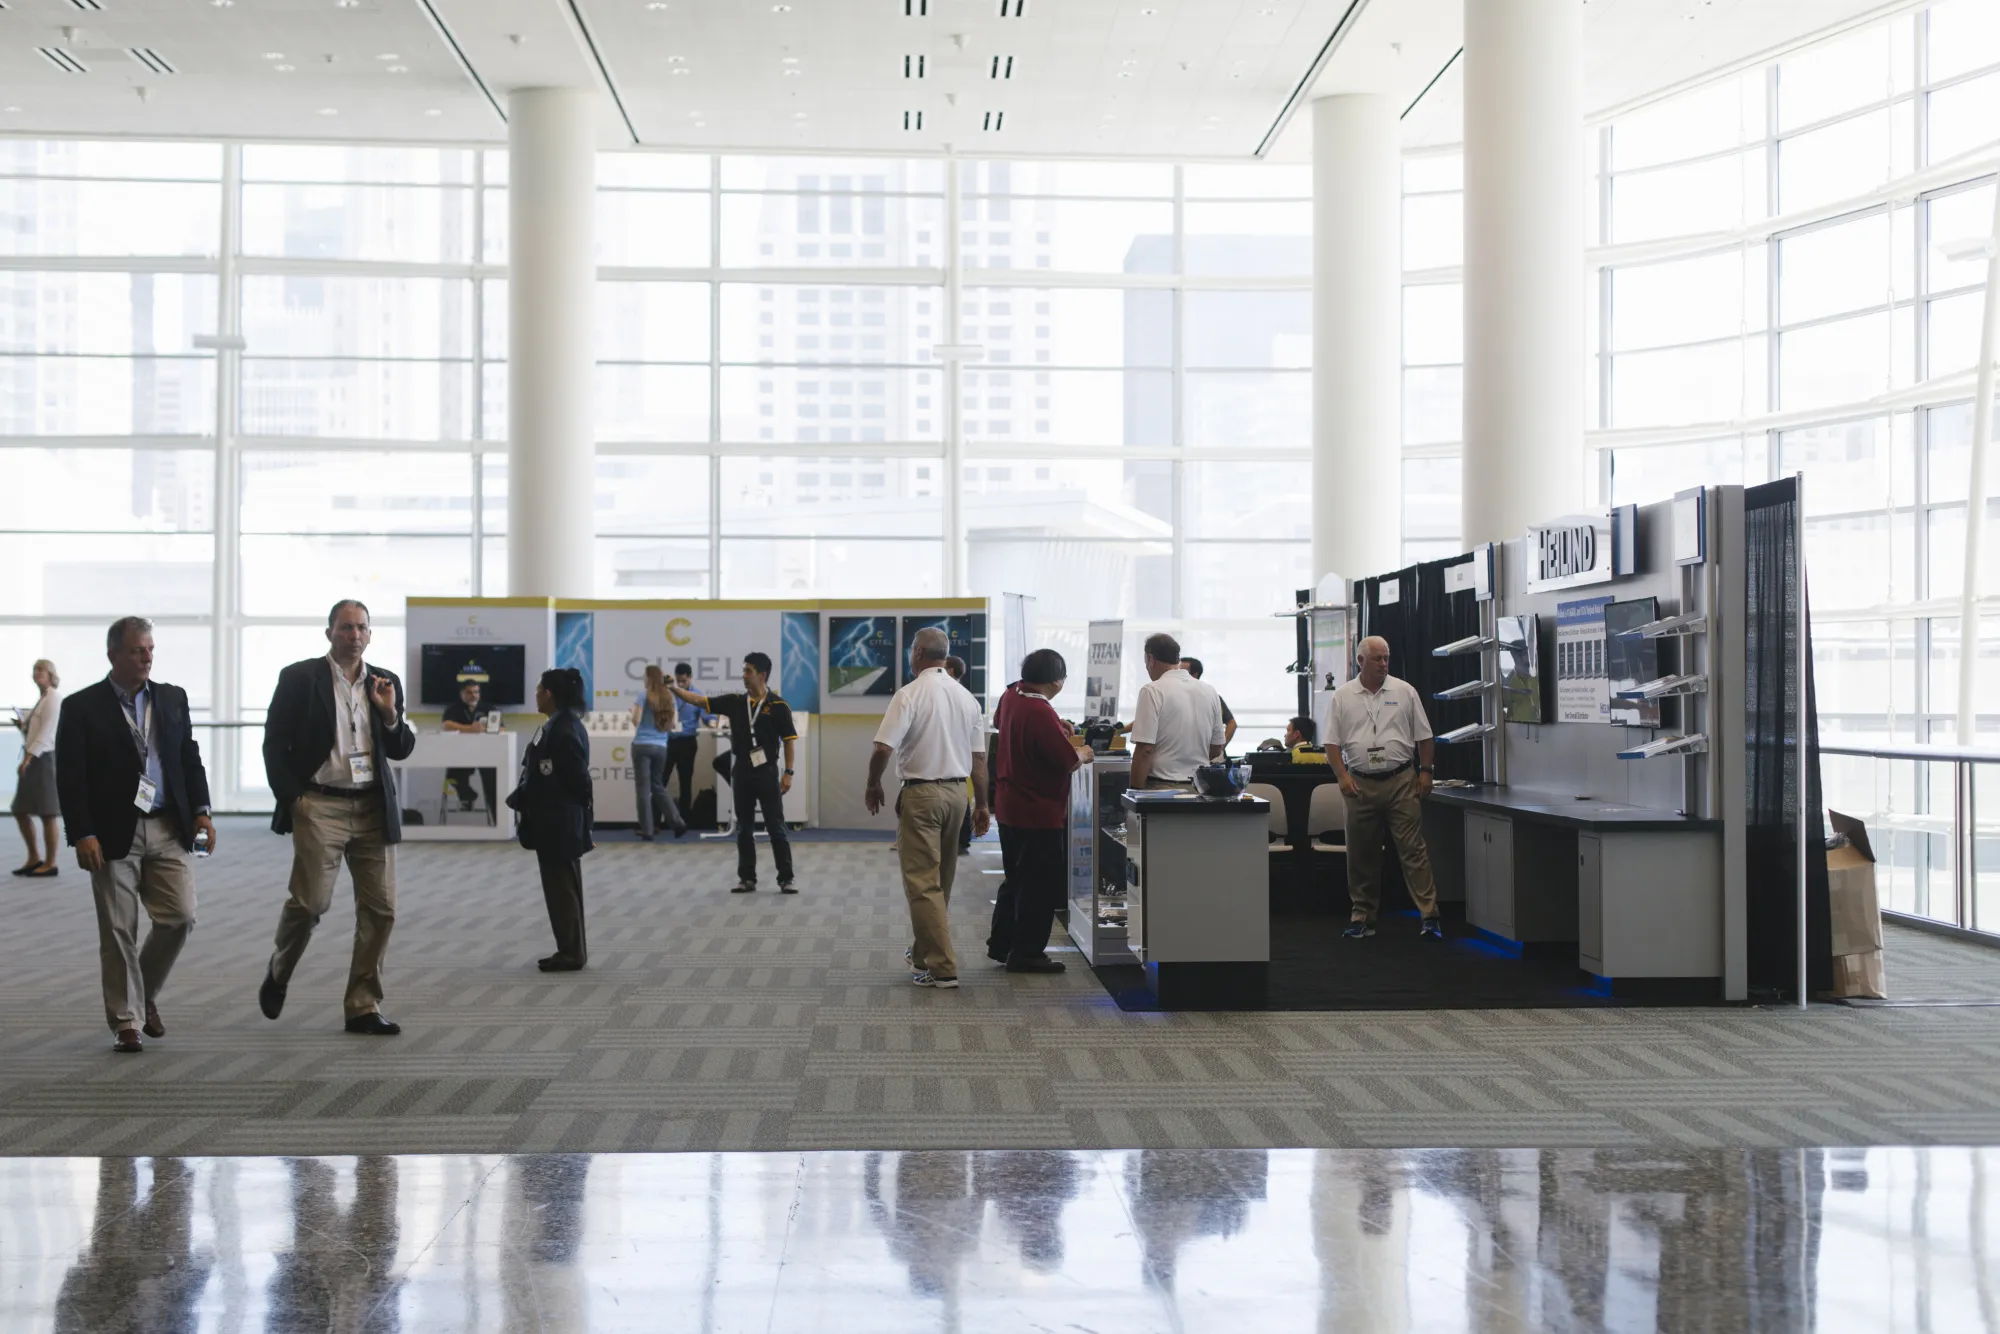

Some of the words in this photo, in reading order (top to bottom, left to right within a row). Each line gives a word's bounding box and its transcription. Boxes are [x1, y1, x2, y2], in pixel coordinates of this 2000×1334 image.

[1539, 525, 1596, 580] HEILIND
[455, 626, 493, 636] CITEL
[1092, 642, 1121, 659] TITAN
[590, 766, 635, 780] CITE
